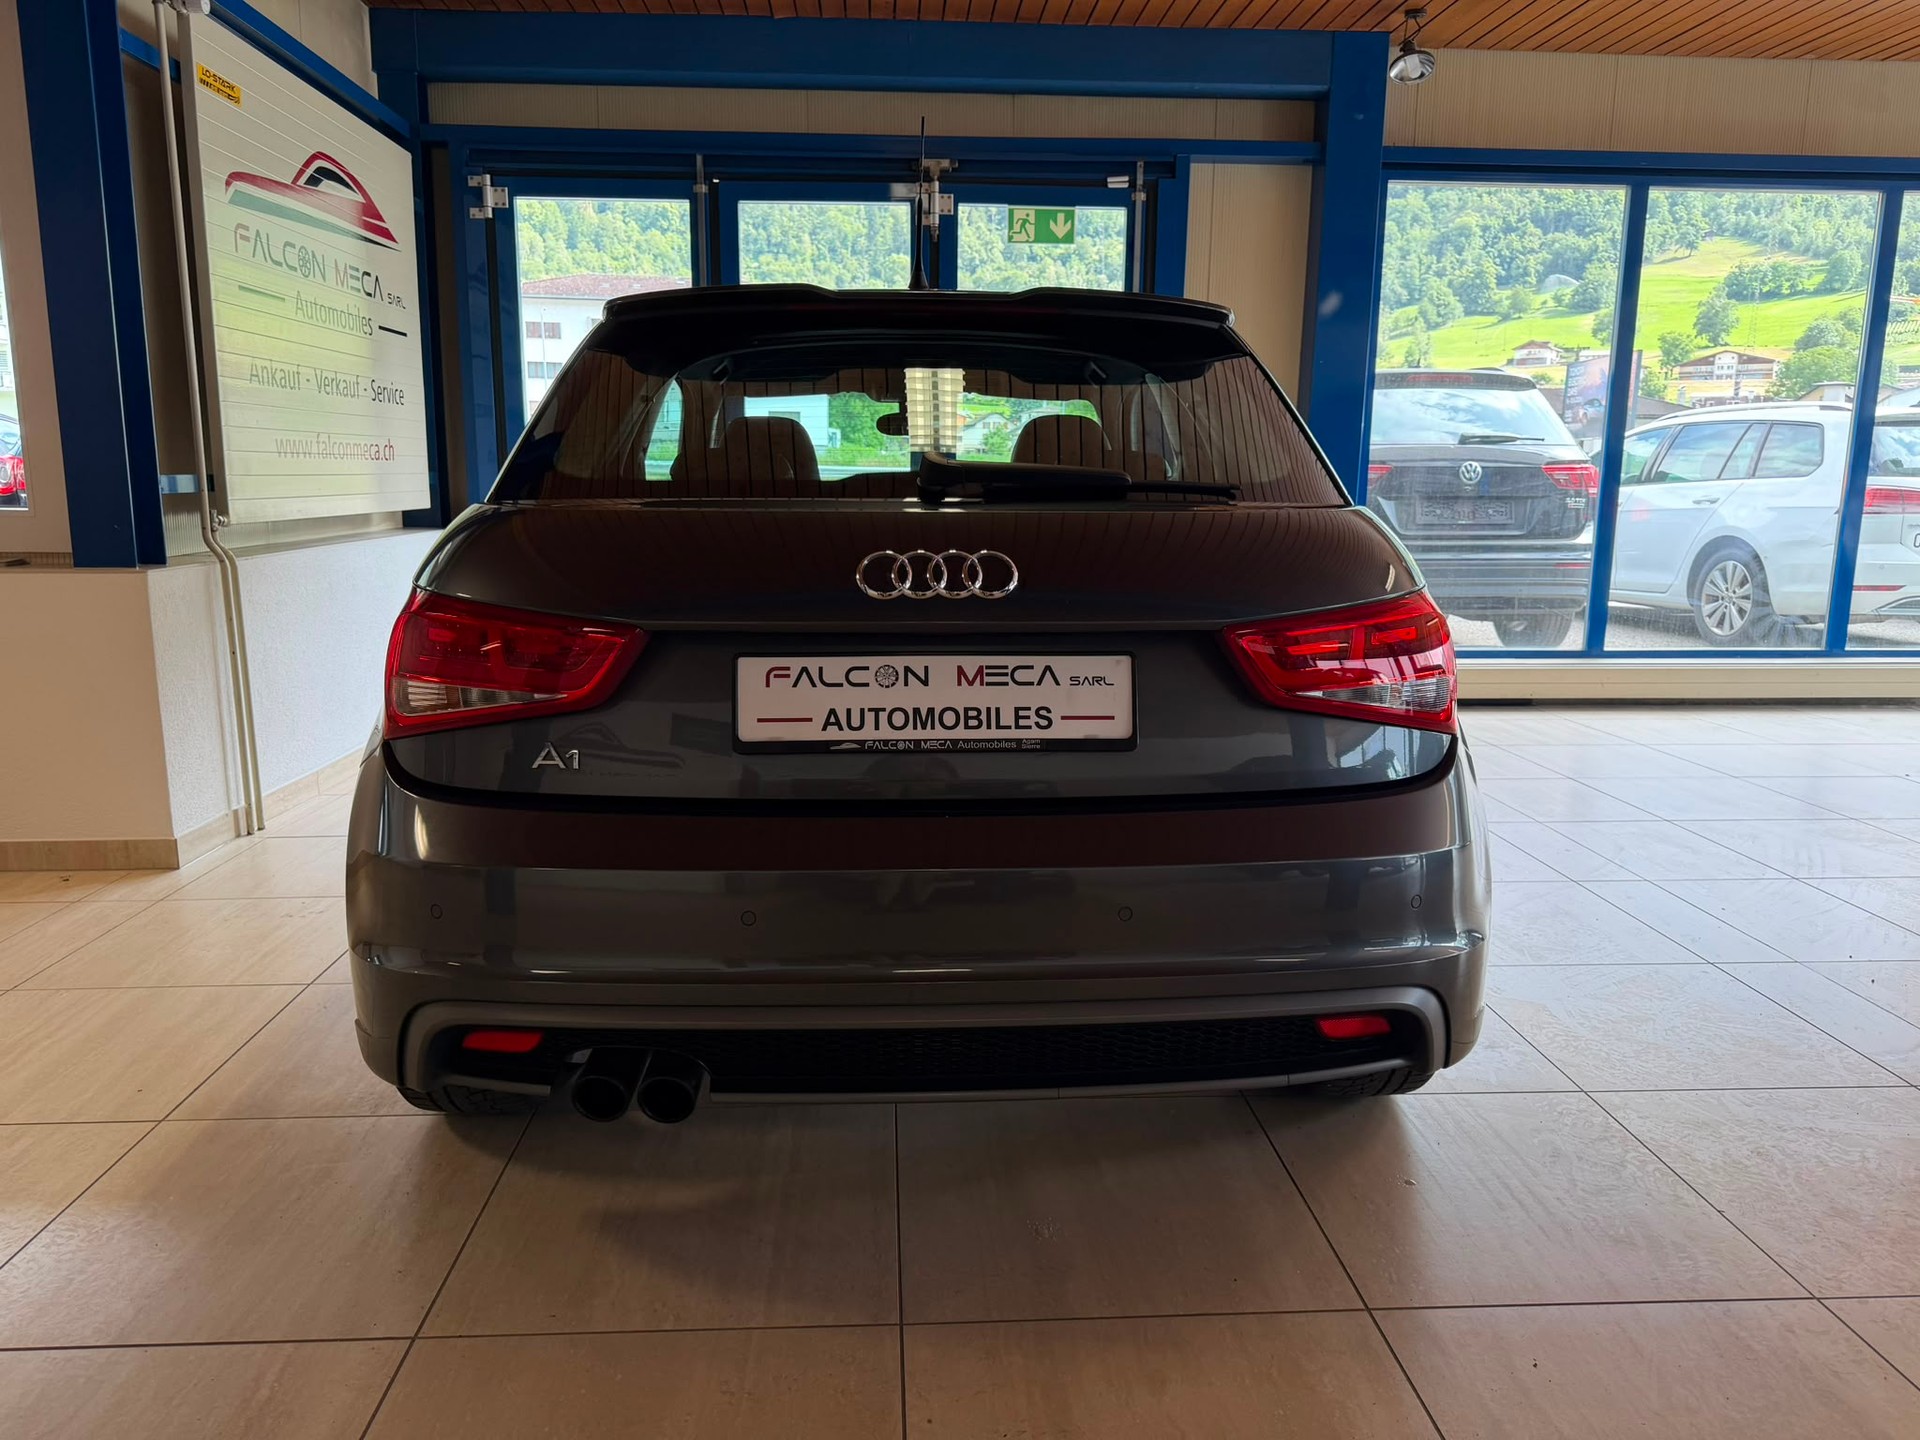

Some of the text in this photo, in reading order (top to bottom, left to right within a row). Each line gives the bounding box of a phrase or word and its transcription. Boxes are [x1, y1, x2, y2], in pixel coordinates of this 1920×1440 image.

[234, 222, 406, 310] FALCON MECA SARL
[295, 290, 373, 336] Automobiles
[249, 359, 301, 391] Ankauf
[314, 367, 360, 400] Verkauf
[370, 378, 405, 406] Service
[275, 432, 395, 462] www.falconmeca.ch
[764, 664, 1115, 689] FALCON MECA SARL
[821, 706, 1054, 732] AUTOMOBILES
[531, 741, 581, 770] A1
[865, 739, 1017, 750] FALCON MECA Automobiles
